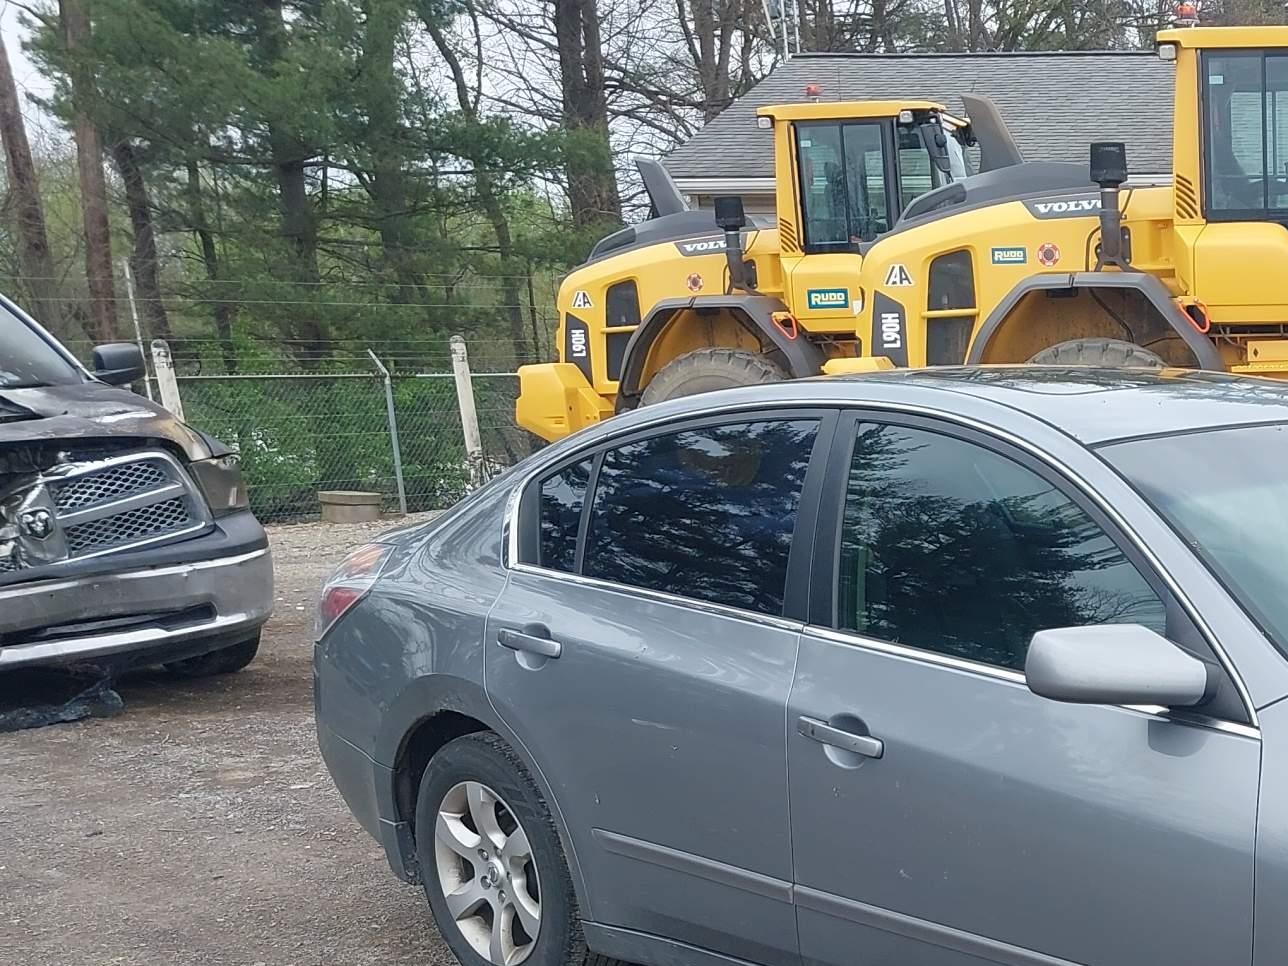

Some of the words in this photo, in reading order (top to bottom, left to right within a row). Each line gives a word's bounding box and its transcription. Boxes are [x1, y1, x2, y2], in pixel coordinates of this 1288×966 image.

[1034, 199, 1102, 213] VOLV
[683, 240, 728, 252] VOLV
[994, 250, 1024, 262] RUDD
[811, 292, 846, 306] RUDD
[881, 312, 902, 349] L90H
[570, 328, 587, 358] L90H
